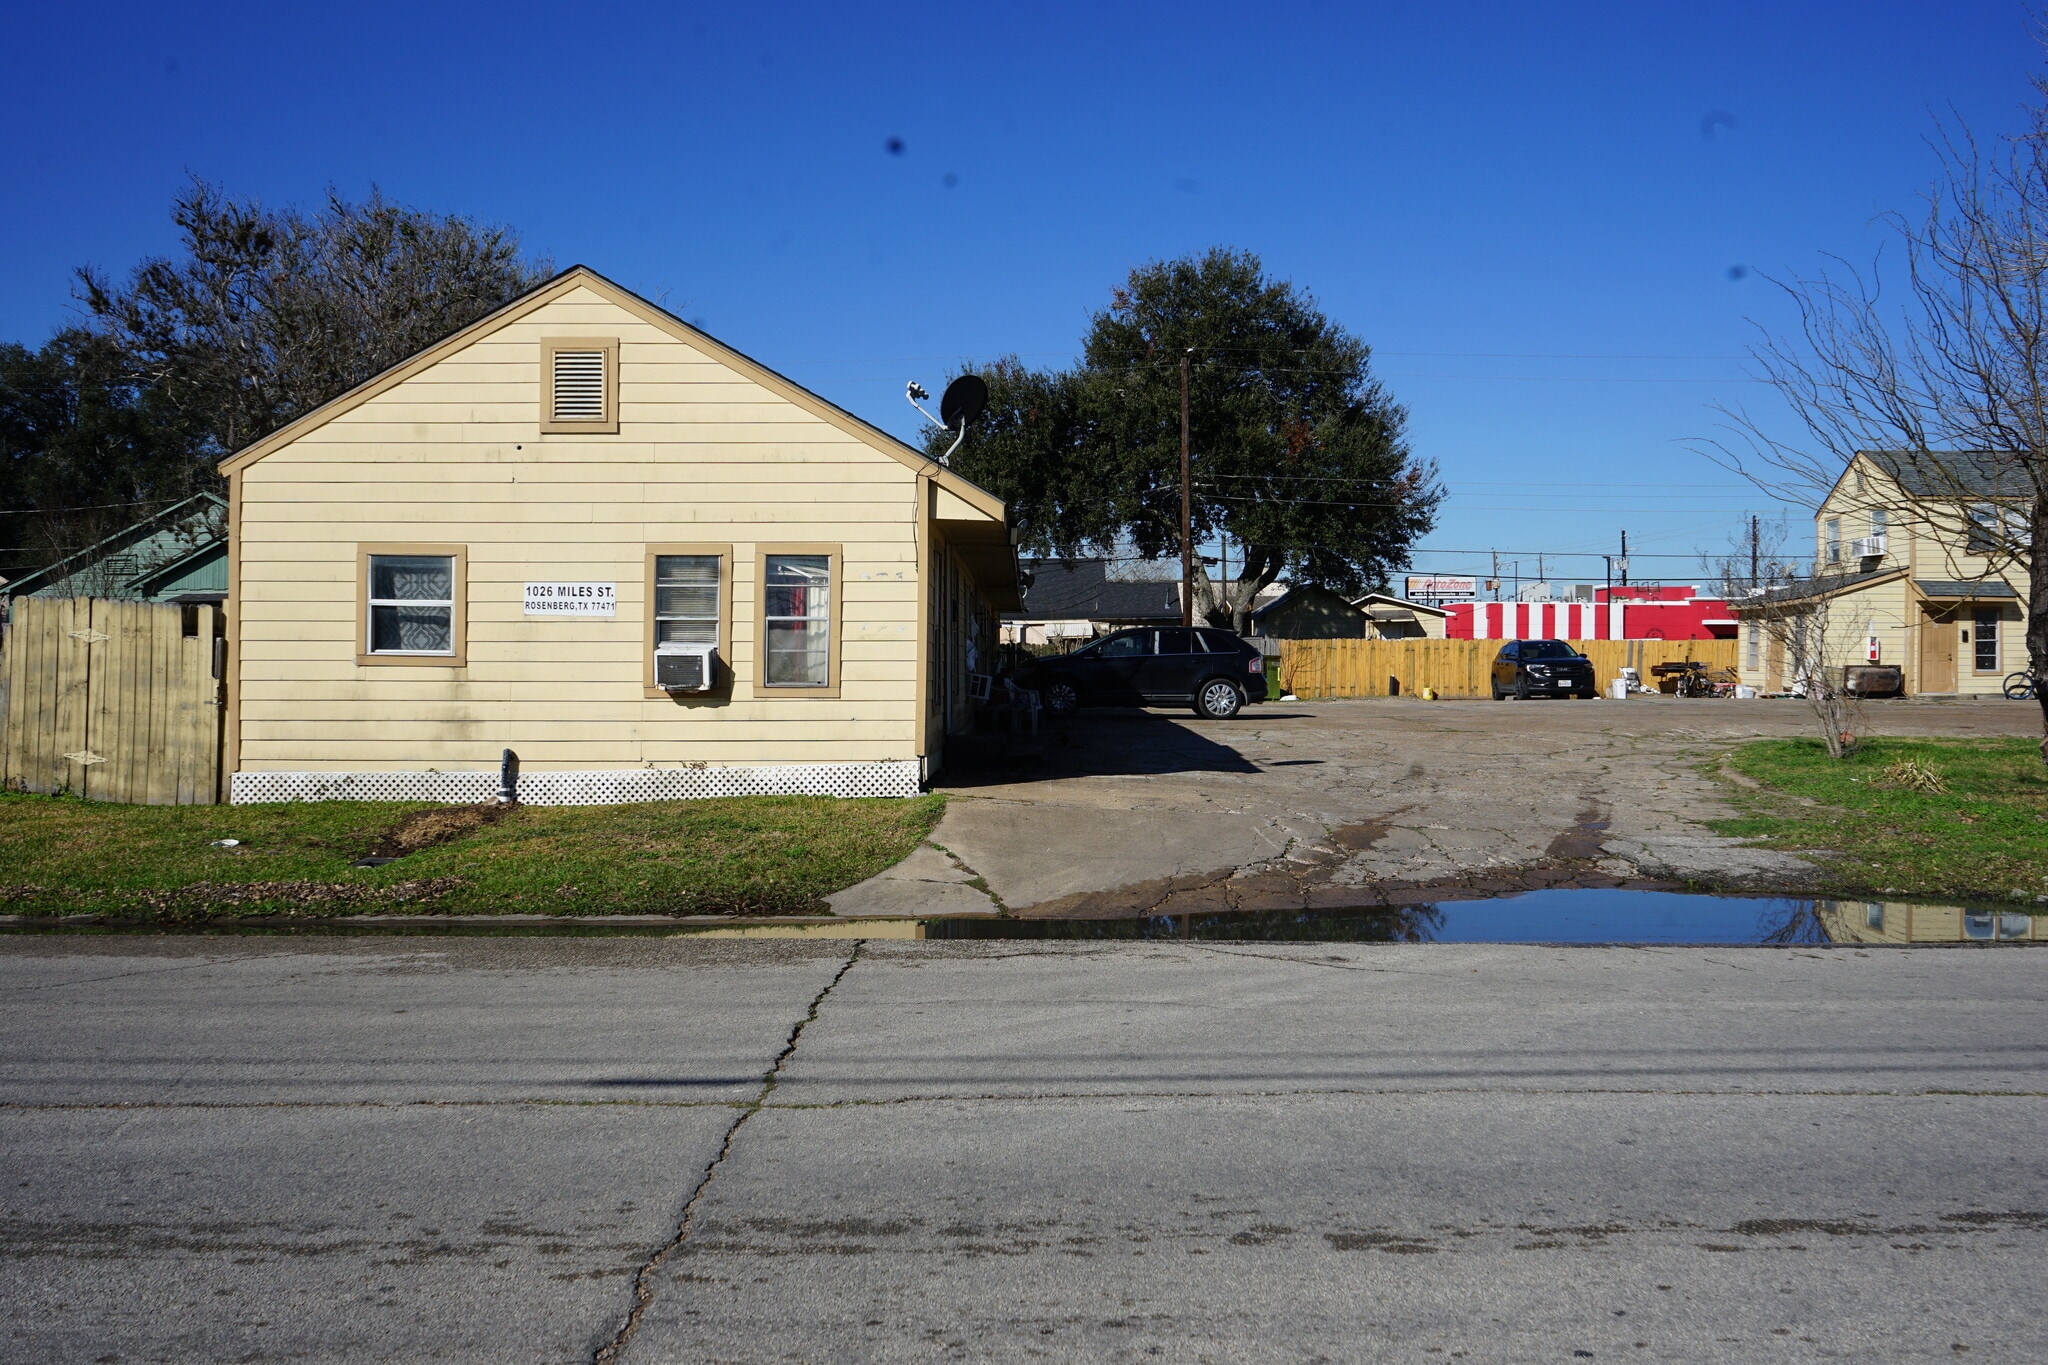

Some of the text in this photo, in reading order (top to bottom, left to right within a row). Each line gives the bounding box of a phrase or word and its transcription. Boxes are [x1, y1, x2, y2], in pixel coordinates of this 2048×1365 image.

[1423, 579, 1472, 590] AutoZone
[526, 586, 614, 597] 1026 MILES ST.
[591, 602, 615, 610] 77471
